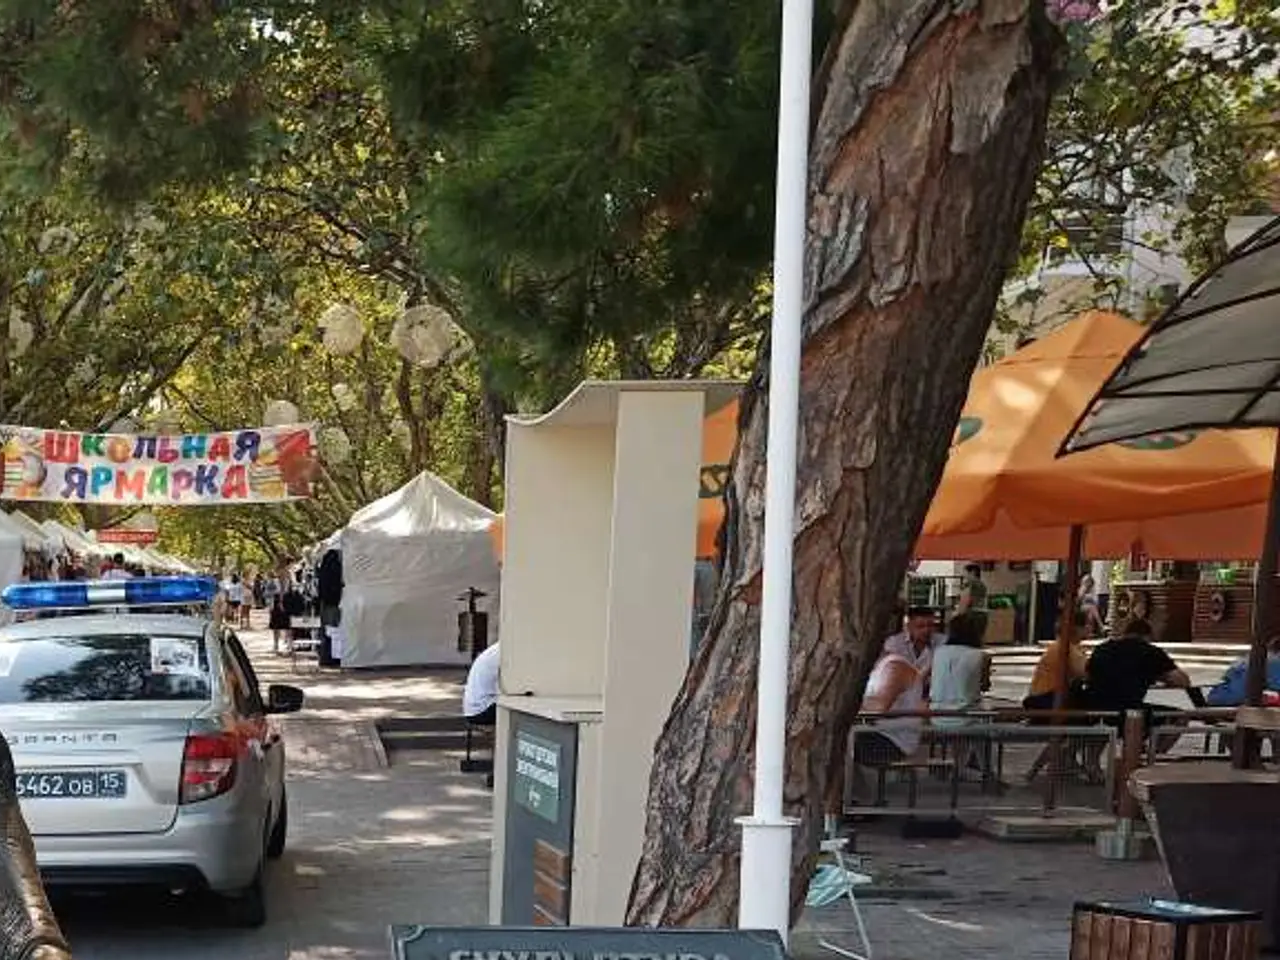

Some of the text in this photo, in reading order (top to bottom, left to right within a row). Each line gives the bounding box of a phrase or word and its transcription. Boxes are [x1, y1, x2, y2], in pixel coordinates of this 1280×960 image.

[42, 430, 262, 464] ШКОЛЬНАЯ
[60, 463, 248, 501] ЯРМАРКА
[100, 773, 119, 789] 15
